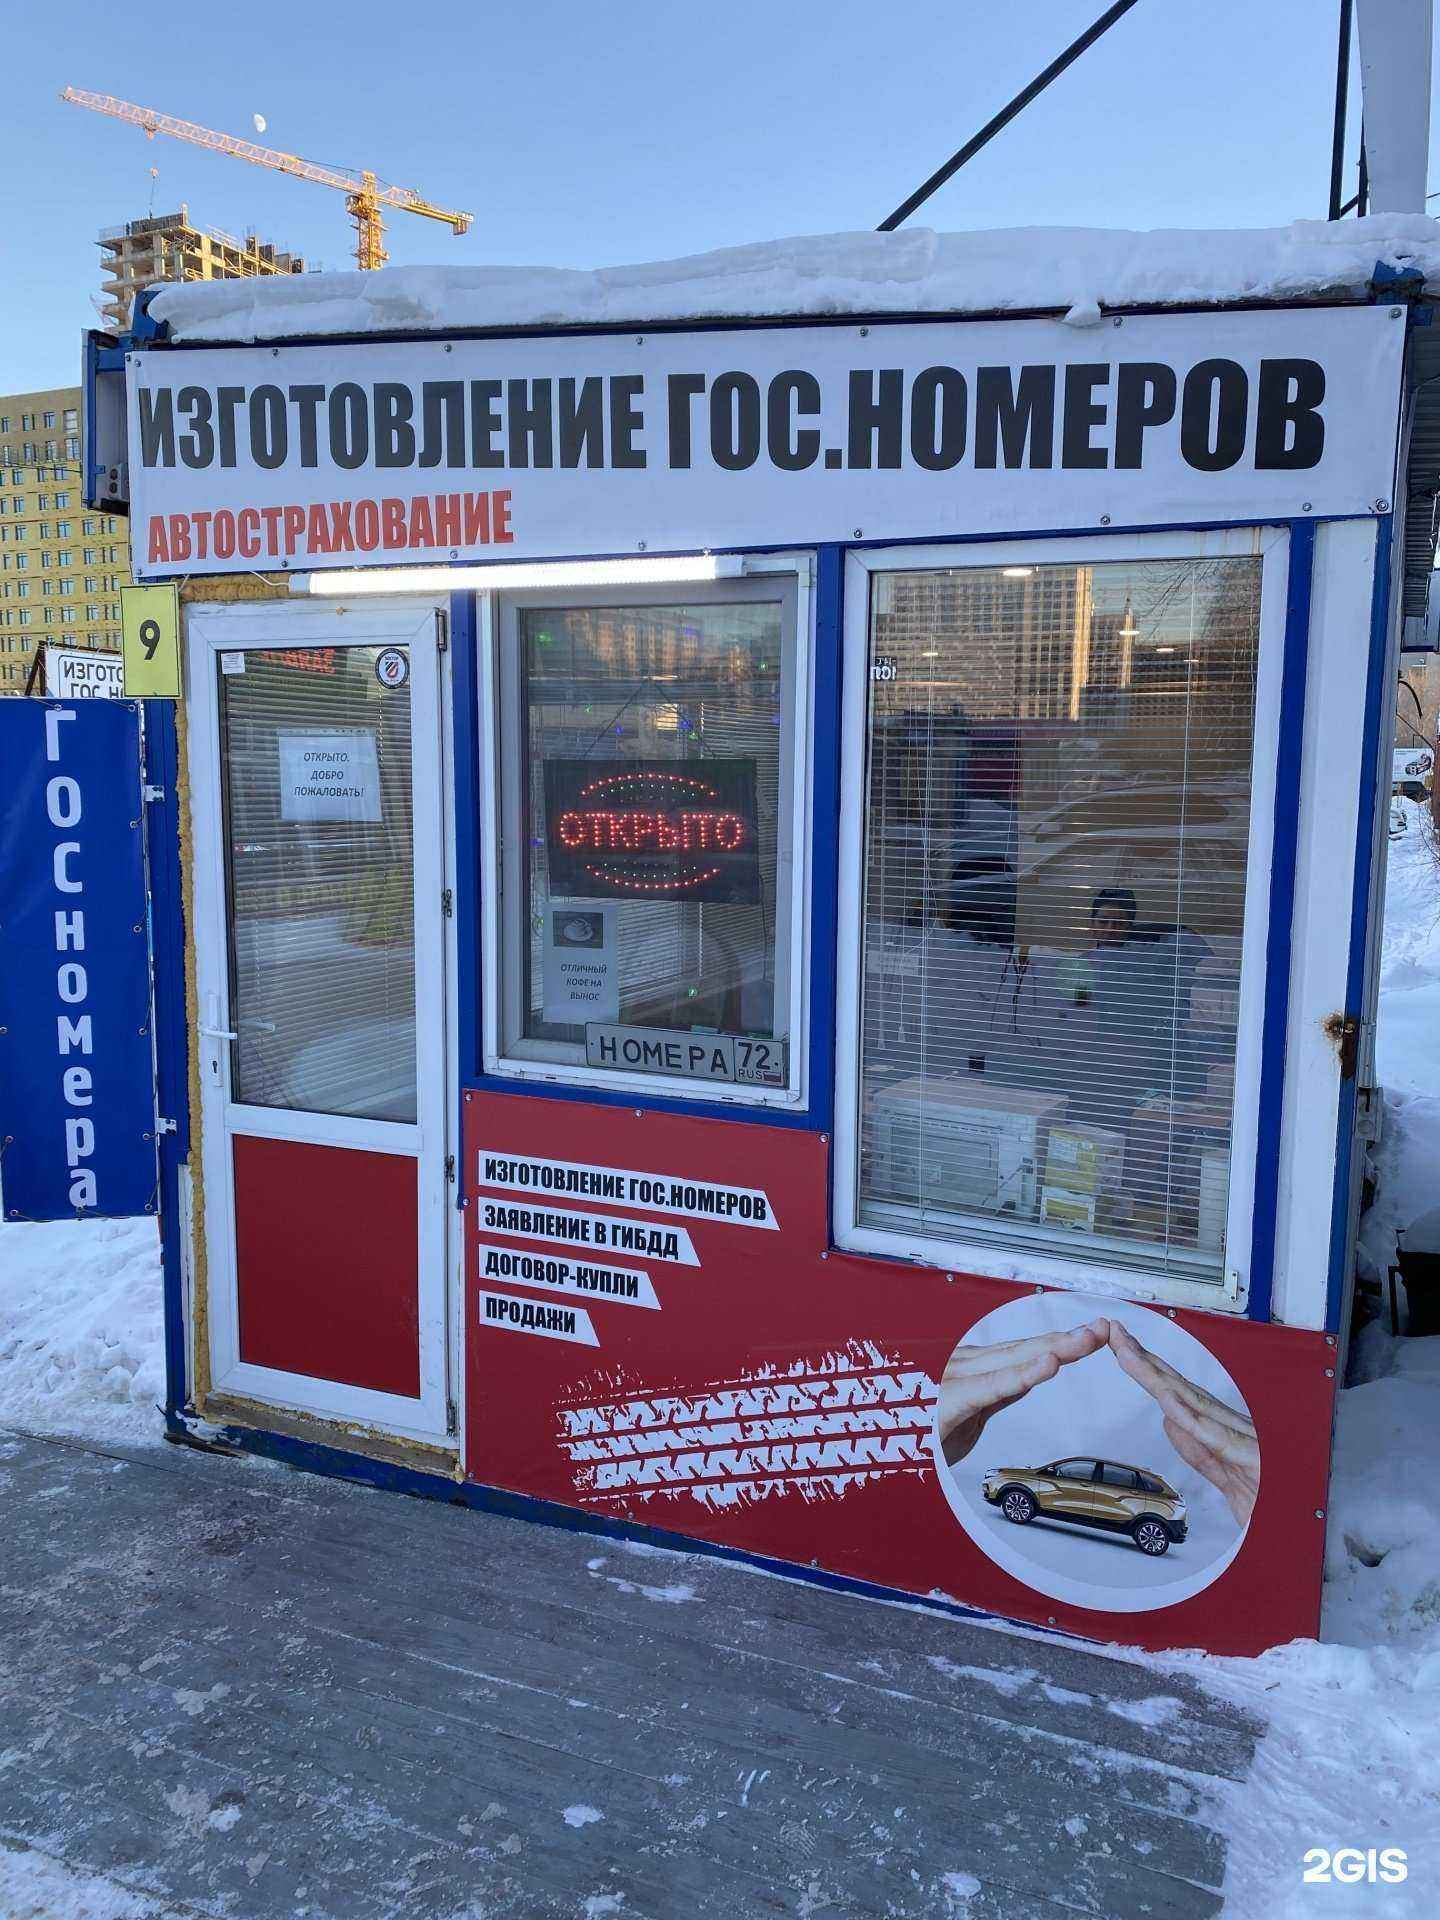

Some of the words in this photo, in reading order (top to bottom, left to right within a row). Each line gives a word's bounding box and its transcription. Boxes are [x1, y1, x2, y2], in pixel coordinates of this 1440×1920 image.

[138, 374, 647, 470] ИЗГОТОВЛЕНИЕ
[667, 358, 1326, 472] ГОС.НОМЕРОВ
[147, 489, 515, 564] АВТОСТРАХОВАНИЕ
[139, 619, 161, 660] 9
[303, 752, 350, 762] ОТКРЫТО.
[310, 770, 344, 781] ДОБРО
[294, 786, 364, 797] ПОЖАЛОВАТЬ!
[560, 811, 744, 849] ОТКРЫТО
[560, 963, 607, 974] ОТЛИЧНЫЙ
[570, 991, 600, 1001] ВЫНОС
[599, 1035, 728, 1075] НОМЕРА
[738, 1041, 771, 1070] 72
[738, 1068, 763, 1080] RUS
[485, 1158, 625, 1200] ИЗГОТОВЛЕНИЕ
[629, 1178, 767, 1221] ГОС.НОМЕРОВ
[485, 1204, 590, 1242] ЗАЯВЛЕНИЕ
[594, 1221, 607, 1244] В
[612, 1224, 679, 1260] ГИБДД
[485, 1251, 639, 1298] ДОГОВОР-КУПЛИ
[485, 1296, 576, 1334] ПРОДАЖИ
